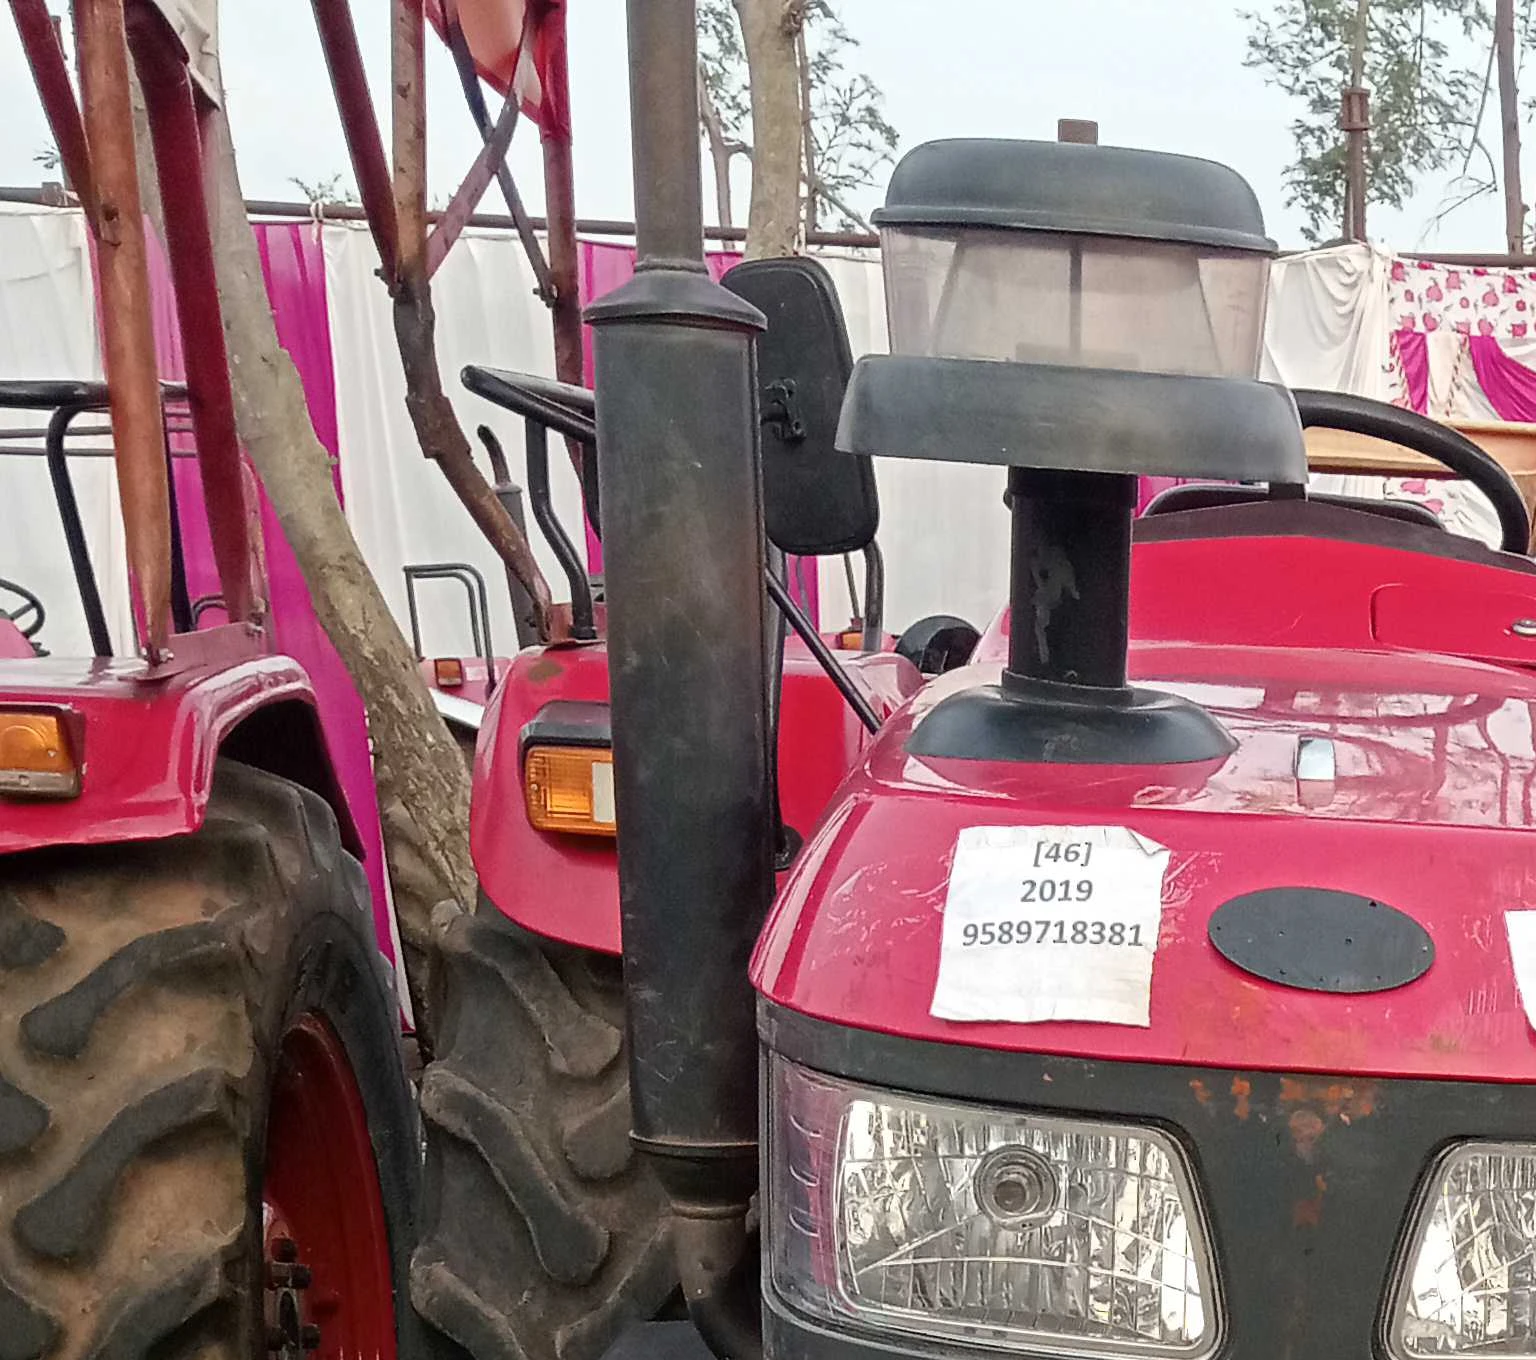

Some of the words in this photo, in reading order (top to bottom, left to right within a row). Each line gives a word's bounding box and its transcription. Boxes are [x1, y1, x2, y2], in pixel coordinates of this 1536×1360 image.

[1033, 841, 1093, 868] [46]
[1020, 879, 1094, 902] 2019
[962, 920, 1144, 947] 9589718381
